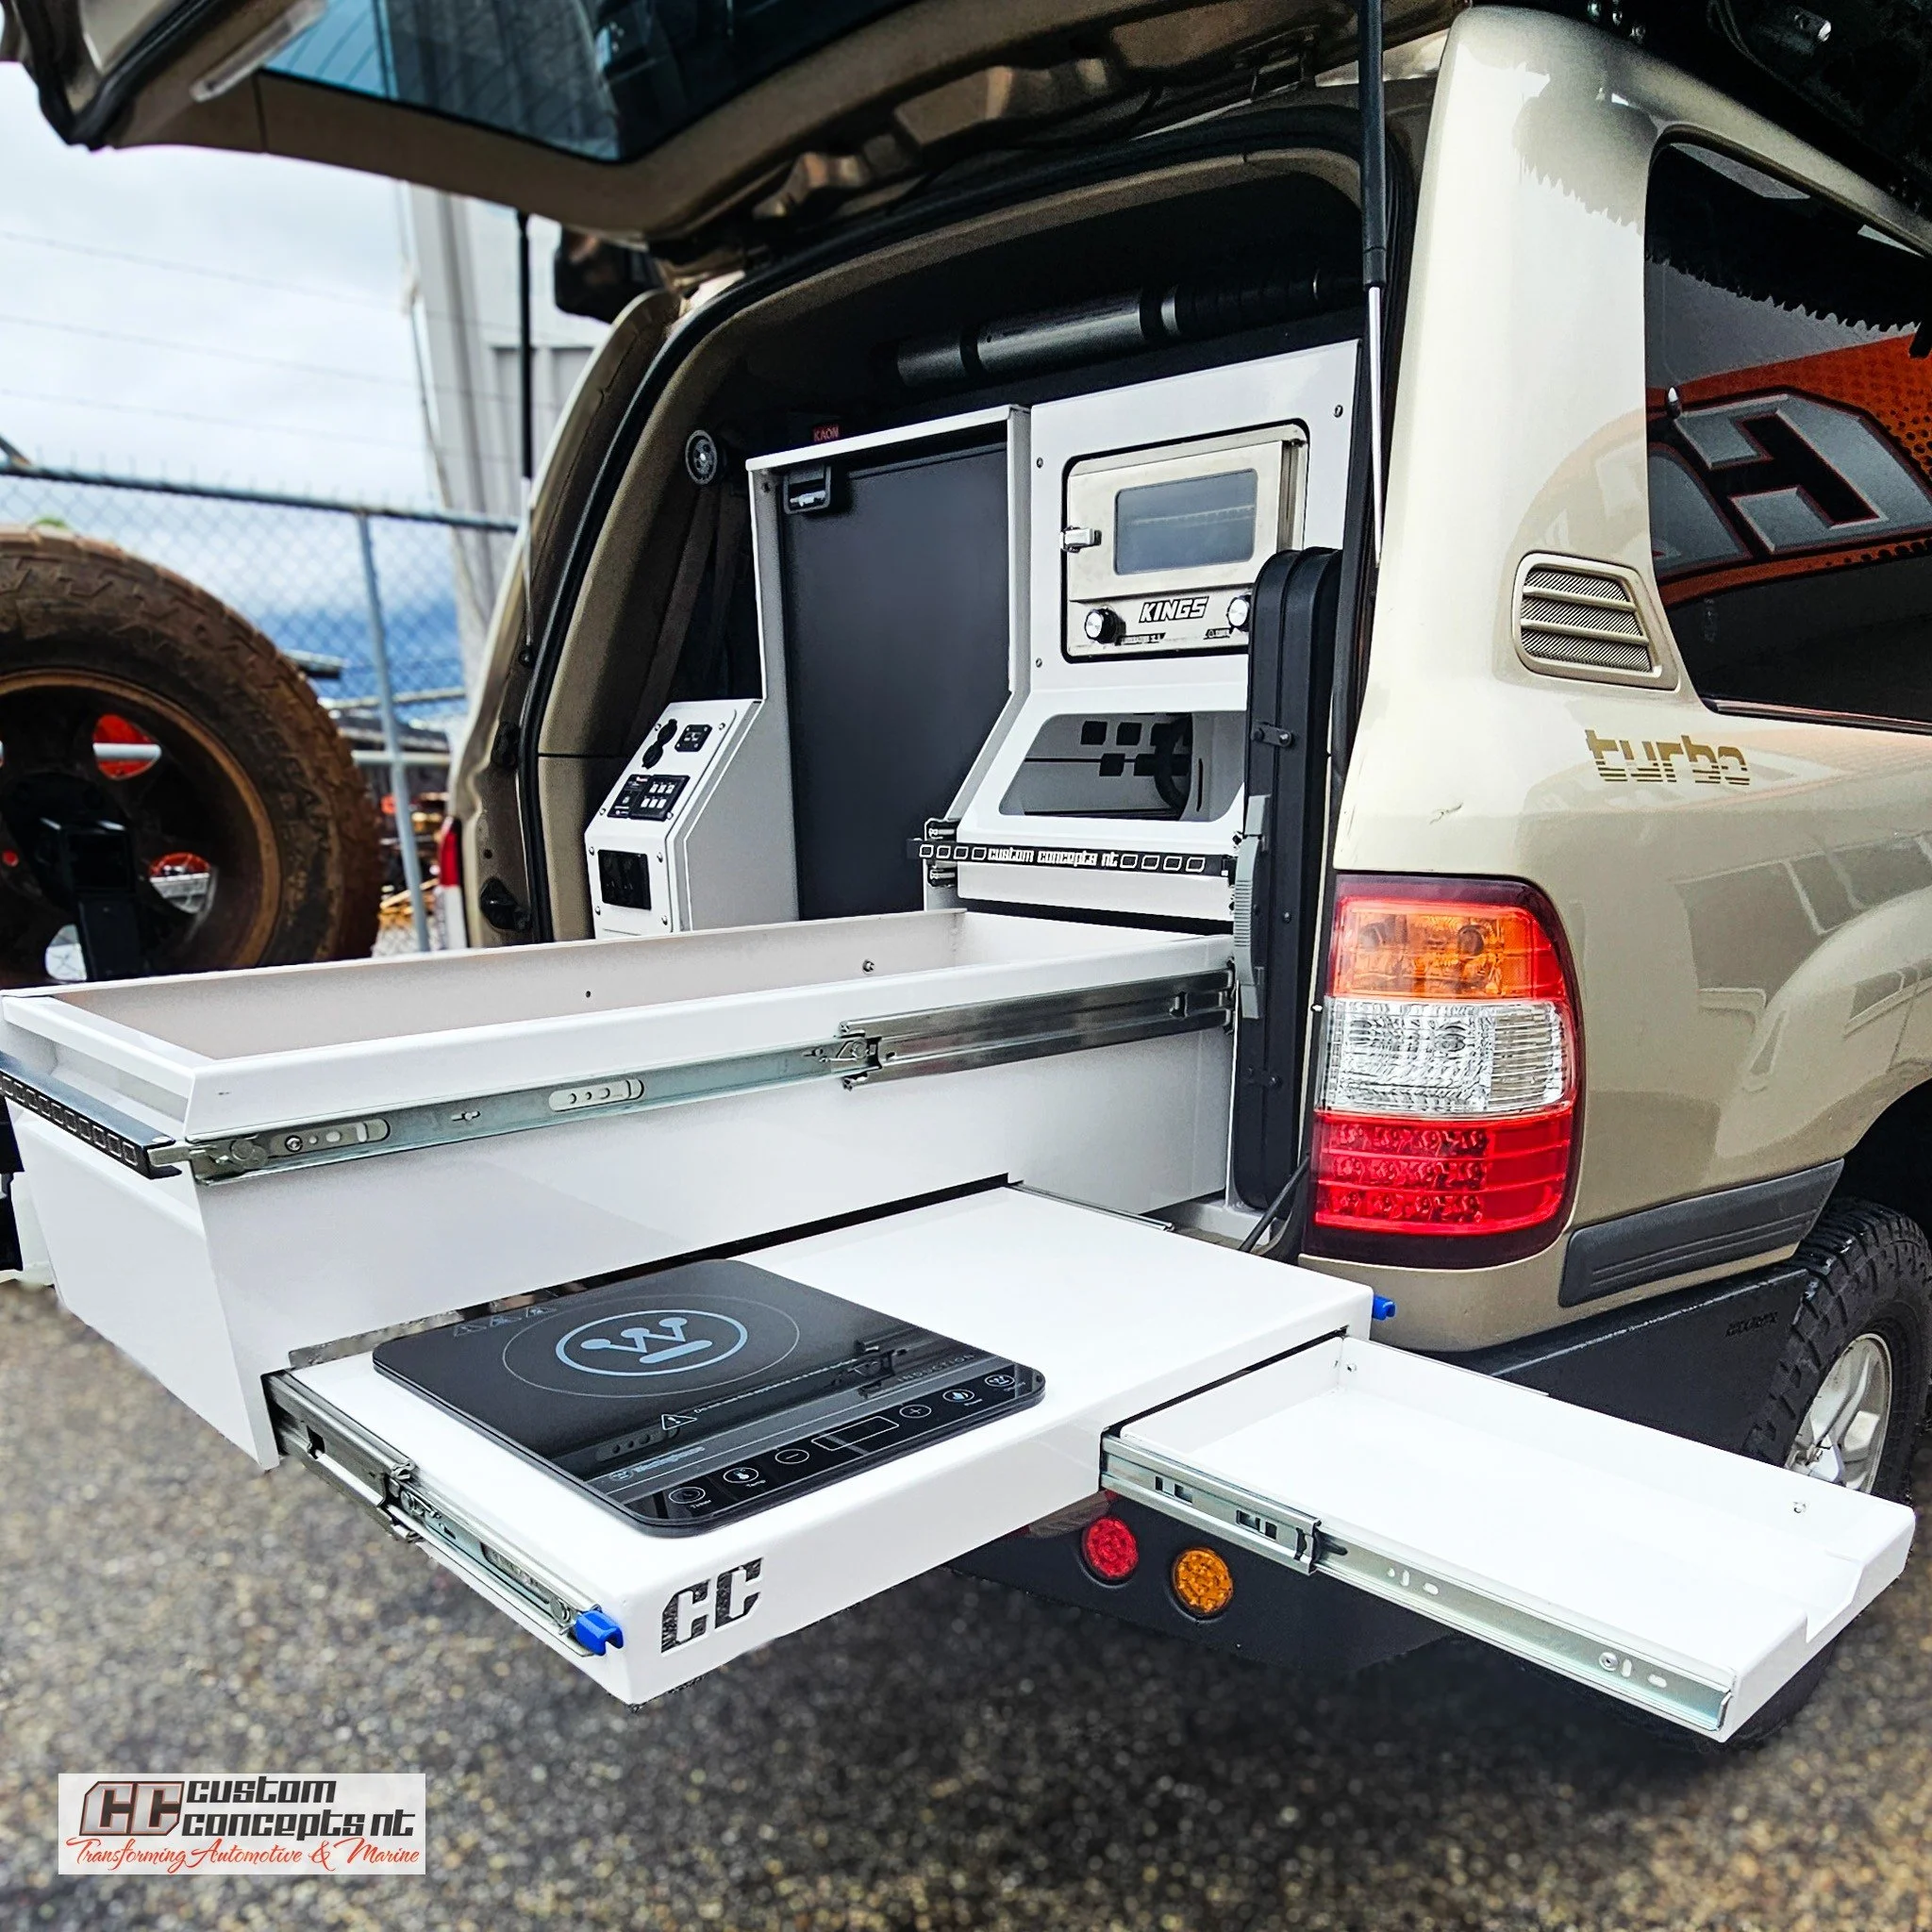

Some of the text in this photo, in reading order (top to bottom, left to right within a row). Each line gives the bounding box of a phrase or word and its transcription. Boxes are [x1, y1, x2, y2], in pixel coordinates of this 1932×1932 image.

[813, 425, 840, 442] KAON
[1139, 596, 1209, 624] KINGS
[1585, 729, 1750, 785] turbo
[988, 849, 1035, 863] custom
[661, 1557, 763, 1654] CC
